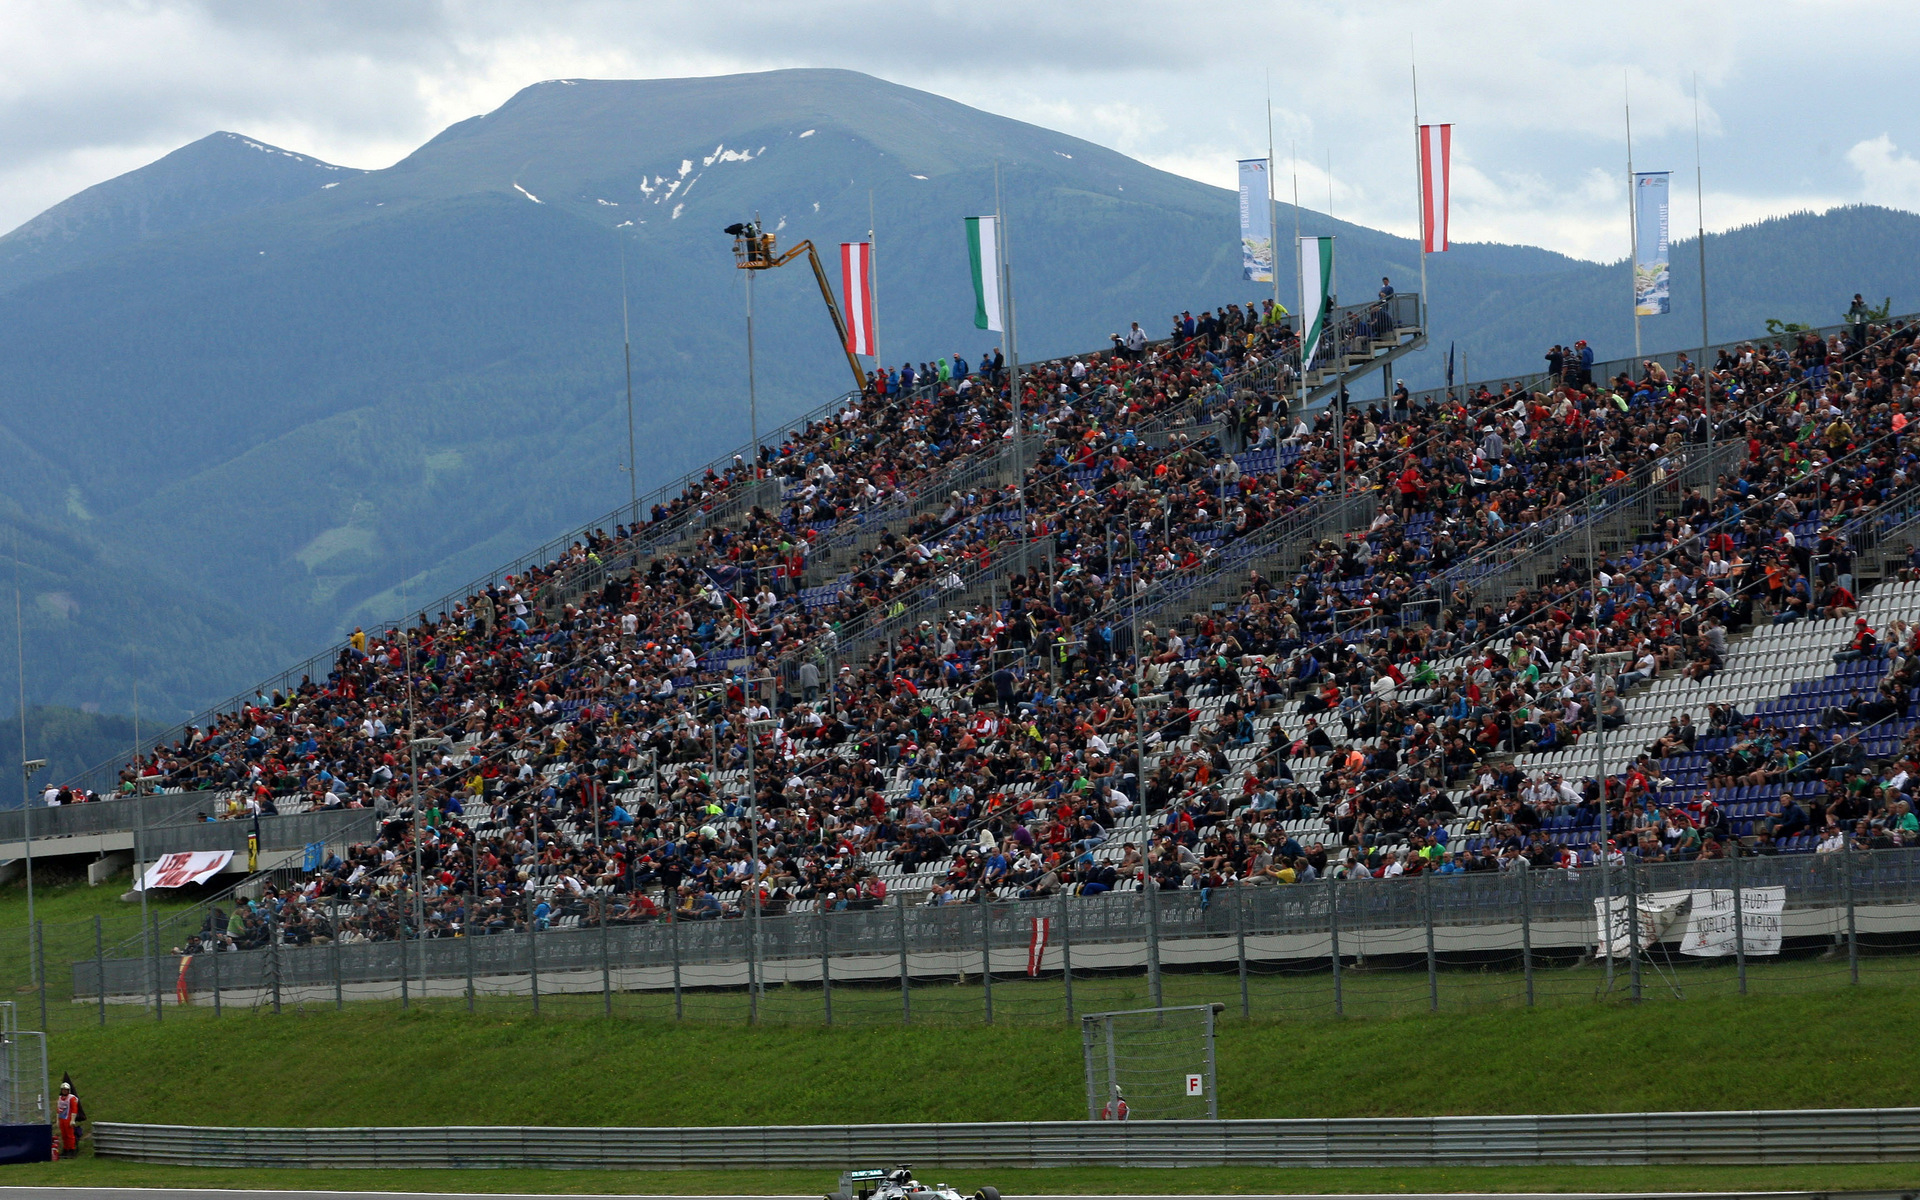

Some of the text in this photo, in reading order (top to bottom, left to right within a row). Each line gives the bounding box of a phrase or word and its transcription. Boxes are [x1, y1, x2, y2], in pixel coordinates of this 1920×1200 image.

[1743, 893, 1768, 909] AUDA
[1697, 915, 1778, 933] WORLD CAMPION
[1190, 1078, 1198, 1091] F
